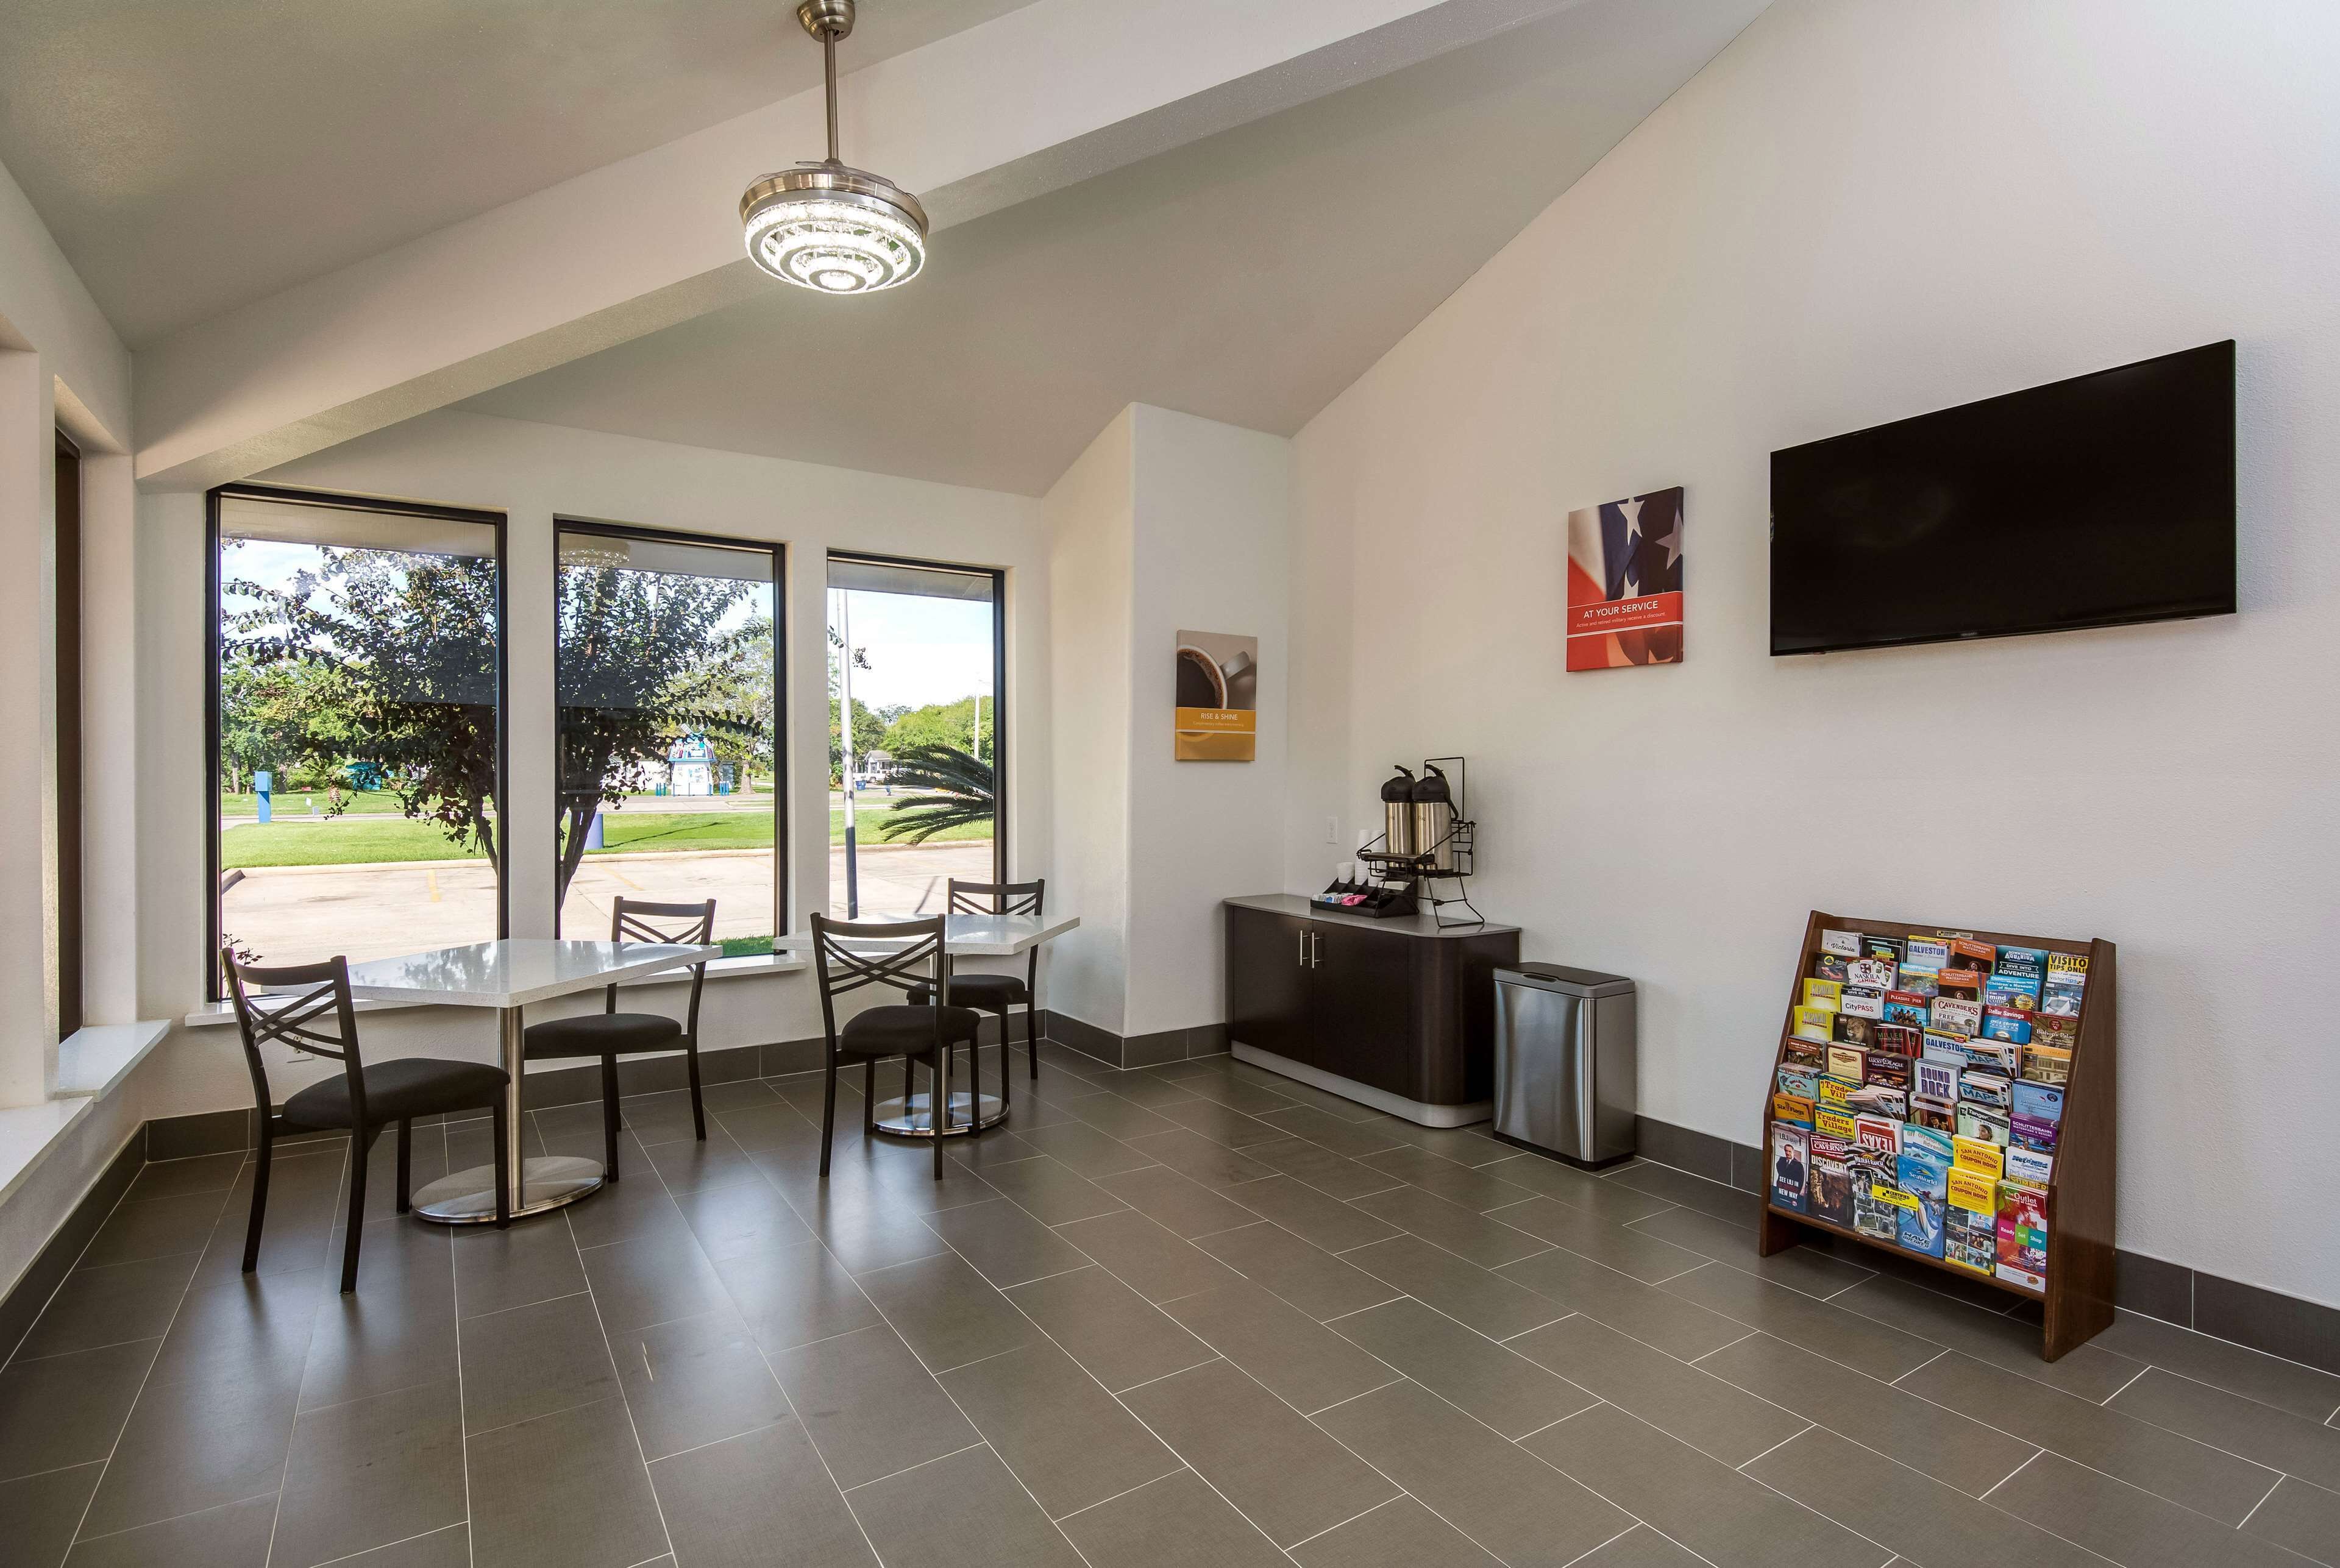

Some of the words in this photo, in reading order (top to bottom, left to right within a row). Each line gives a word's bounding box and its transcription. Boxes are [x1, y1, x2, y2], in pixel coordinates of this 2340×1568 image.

[1584, 610, 1594, 619] AT
[1596, 606, 1619, 617] YOUR
[1622, 600, 1658, 613] SERVICE
[1830, 942, 1855, 952] Victoria
[1909, 945, 1945, 956] GALVESTON
[1959, 941, 1990, 952] SCHLITTERBAHN
[2005, 953, 2035, 962] AQUARIUM
[1998, 970, 2039, 979] ADVENTURE
[2067, 965, 2088, 974] ONLI
[1845, 1003, 1874, 1012] CityPASS
[1938, 1001, 1978, 1016] CAVENDER'S
[2036, 1029, 2058, 1037] Bishop's
[1966, 1054, 2002, 1065] MAPS
[1921, 1066, 1951, 1084] ROUND
[1825, 1080, 1854, 1093] Trade
[1921, 1079, 1951, 1098] ROCK
[1963, 1088, 2000, 1103] MAPS
[1790, 1106, 1805, 1115] Flags
[1817, 1112, 1850, 1126] Traders
[1968, 1109, 2008, 1127] TangerOutlets
[1822, 1119, 1852, 1133] Village
[1983, 1121, 2005, 1131] DIRECTORY
[2013, 1121, 2052, 1134] SCHLITTERBAHN
[1814, 1143, 1844, 1152] CAVERNS
[1871, 1158, 1884, 1167] RANCH
[1960, 1154, 1982, 1165] COUPON
[1982, 1161, 1998, 1170] BOOK
[1972, 1150, 1998, 1164] ANTONIO
[1812, 1155, 1847, 1173] DISCOVERY
[1908, 1171, 1937, 1186] SeaWorld
[2011, 1177, 2047, 1190] SUMMER
[1788, 1191, 1798, 1199] WAY
[1951, 1186, 1972, 1196] COUPON
[1972, 1192, 1988, 1201] BOOK
[1964, 1182, 1988, 1195] ANTONIO
[1890, 1191, 1910, 1200] CERTIFIED
[2014, 1191, 2037, 1205] Outlet
[1904, 1231, 1931, 1245] WAVE
[2000, 1227, 2015, 1236] Ready
[1902, 1236, 1929, 1249] BREAKER
[2030, 1235, 2042, 1244] Shop
